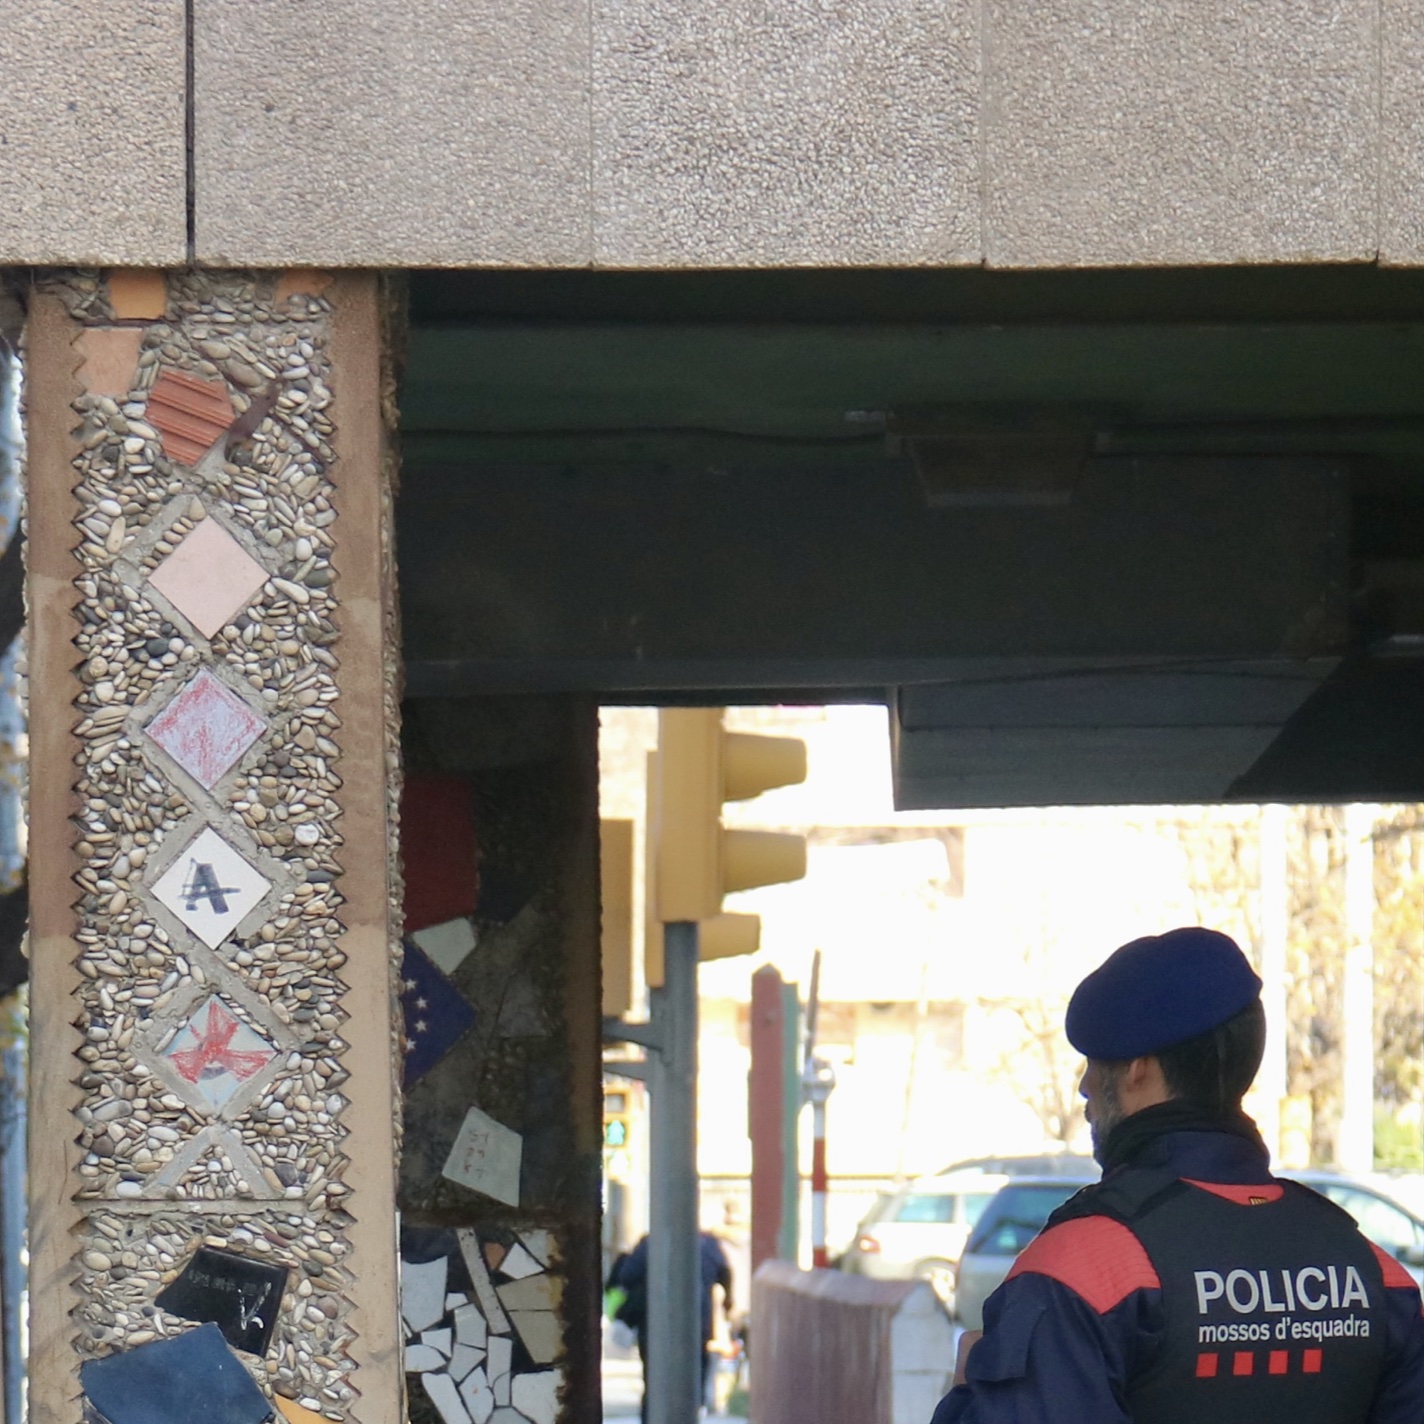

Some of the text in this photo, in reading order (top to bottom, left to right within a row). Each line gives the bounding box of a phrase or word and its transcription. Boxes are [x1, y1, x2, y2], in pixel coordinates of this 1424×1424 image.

[1193, 1265, 1370, 1314] POLICIA
[1198, 1313, 1370, 1343] mossos d'esquadra
